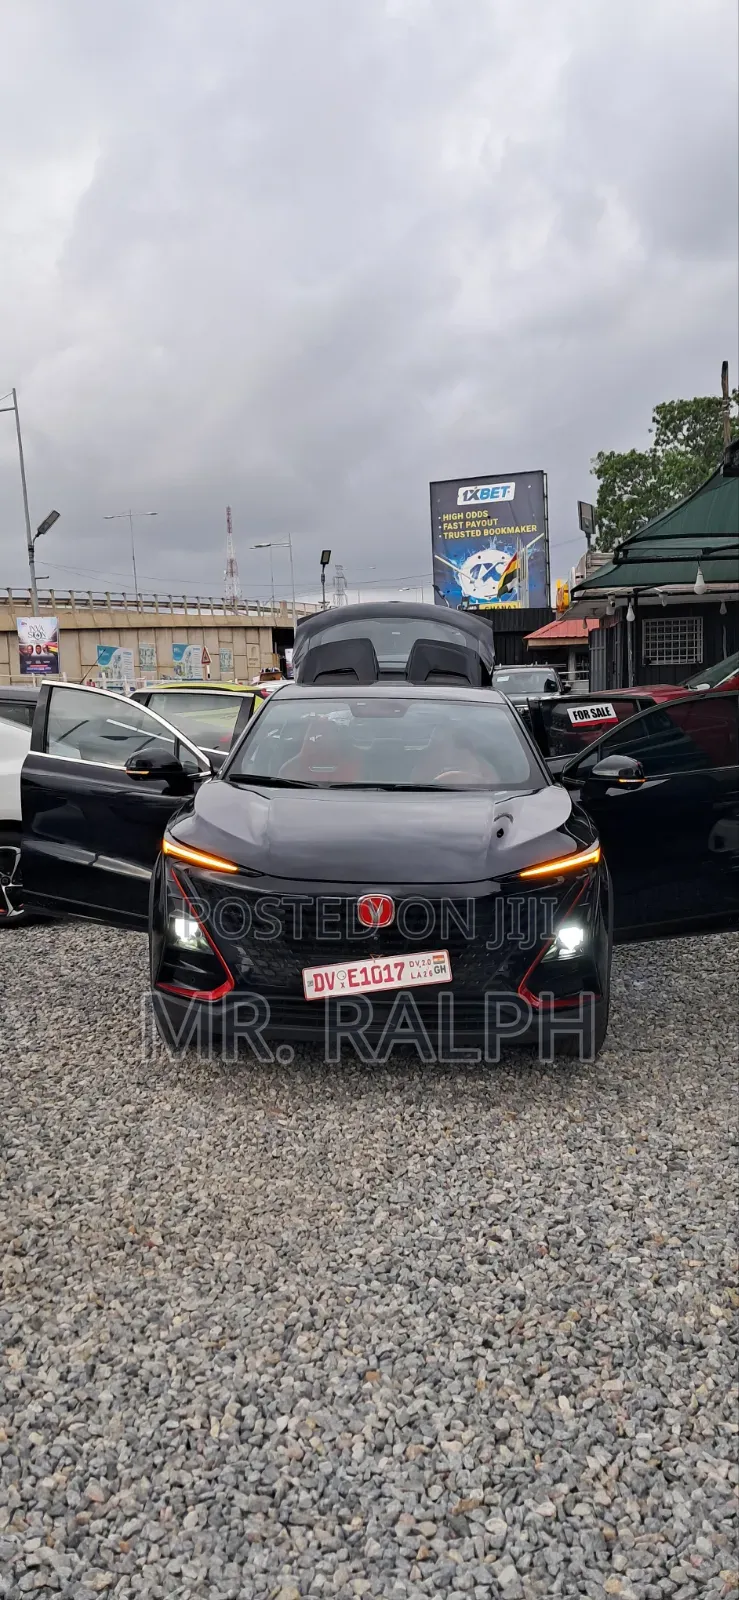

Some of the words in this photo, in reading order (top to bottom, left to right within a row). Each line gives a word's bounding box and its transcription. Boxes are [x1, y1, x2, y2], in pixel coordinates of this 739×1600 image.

[443, 512, 463, 521] HIGH
[465, 510, 489, 519] ODDS
[443, 521, 463, 530] FAST
[465, 518, 499, 528] PAYOUT
[443, 530, 482, 540] TRUSTED
[483, 524, 537, 537] BOOKMAKER
[572, 709, 590, 720] FOR
[591, 707, 611, 719] SALE
[433, 964, 447, 975] GH
[313, 972, 335, 992] DV
[347, 962, 405, 987] E1017
